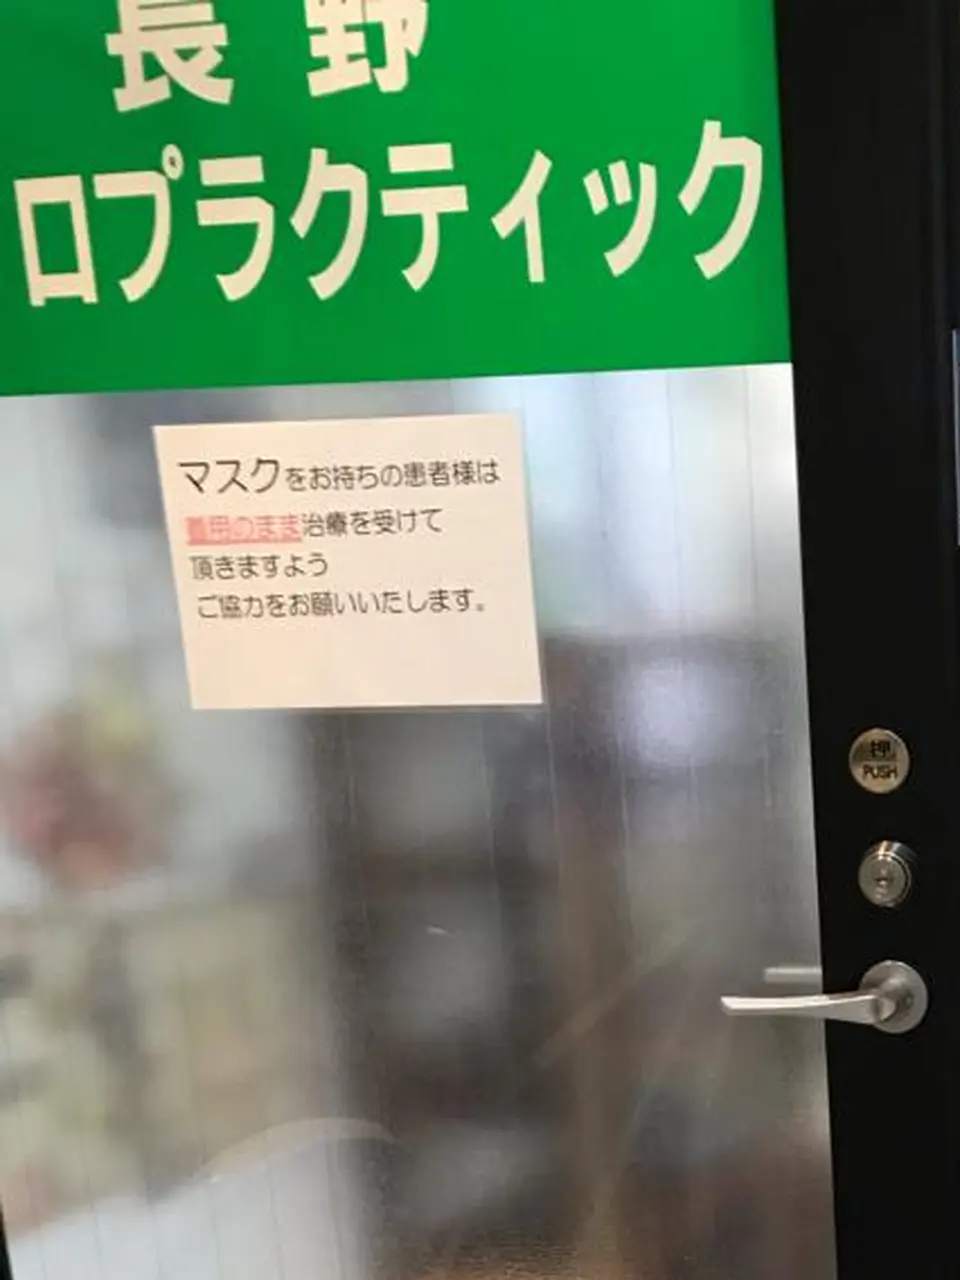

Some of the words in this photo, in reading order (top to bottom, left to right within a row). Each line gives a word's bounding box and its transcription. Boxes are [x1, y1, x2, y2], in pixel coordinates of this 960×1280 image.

[13, 118, 764, 308] ロプラクティック
[177, 457, 501, 495] マスクをお持ちの患者様は
[189, 551, 330, 581] 頂きますよう
[197, 588, 486, 620] ご協力をお願いいたします。
[870, 740, 891, 759] 押
[862, 764, 898, 780] PUSH
